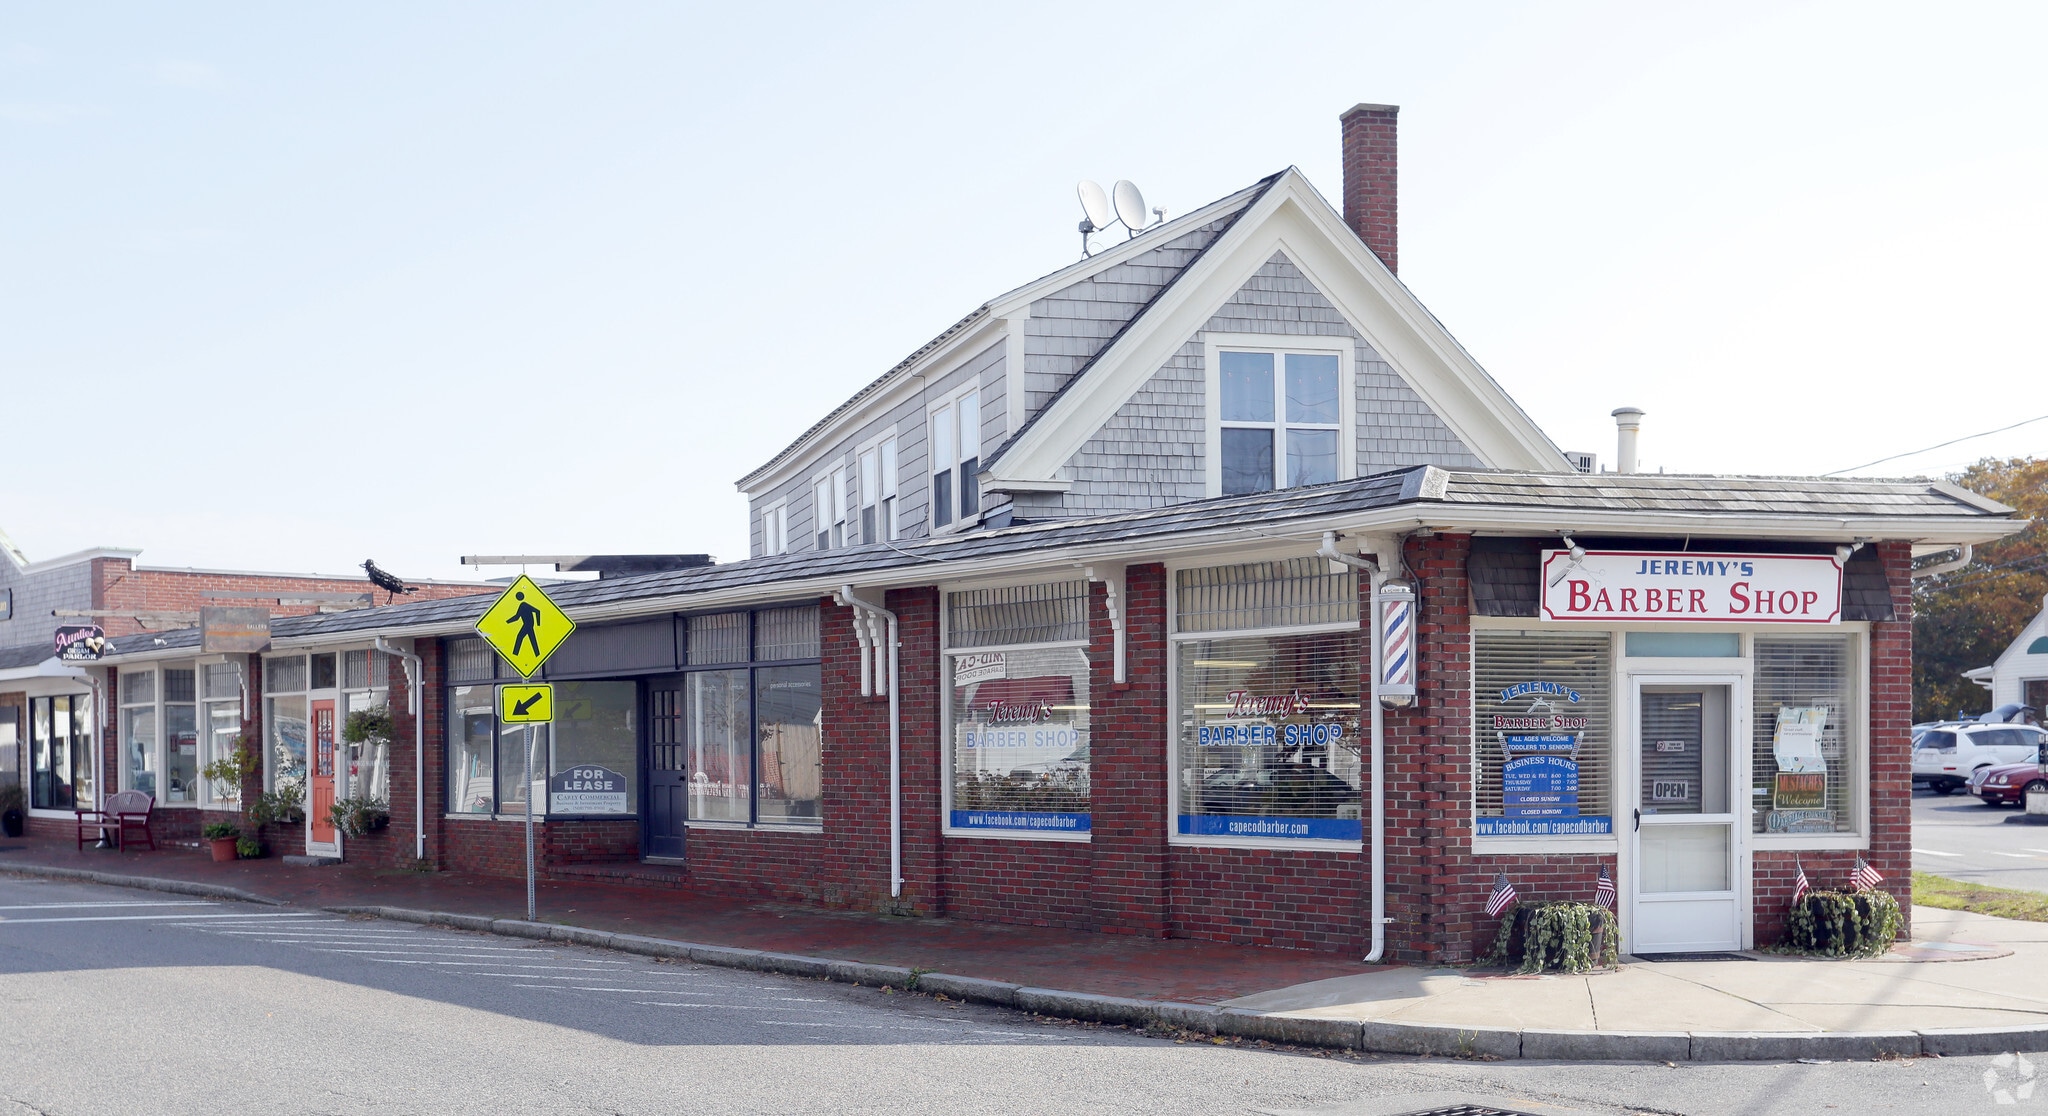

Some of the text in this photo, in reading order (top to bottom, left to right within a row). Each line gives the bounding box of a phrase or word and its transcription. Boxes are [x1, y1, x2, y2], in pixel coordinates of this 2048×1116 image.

[1636, 560, 1753, 576] JEREMY'S
[1567, 579, 1818, 615] BARBER SHOP
[1500, 681, 1581, 704] JEREMY'S
[987, 698, 1054, 727] Jeremy's
[1226, 689, 1311, 720] Jeremy's
[1494, 714, 1589, 729] BARBER SHOP
[966, 729, 1080, 749] BARBER SHOP
[1199, 724, 1343, 746] BARBER SHOP
[1505, 756, 1577, 772] BUSINESS HOURS
[573, 769, 604, 779] FOR
[564, 781, 613, 790] LEASE
[1656, 783, 1685, 797] OPEN
[1779, 775, 1823, 792] MUSTACHES
[1778, 793, 1821, 805] Welcome
[968, 813, 1076, 828] www.facebook.com/capecodbarber
[1229, 820, 1309, 835] capecodbarber.com
